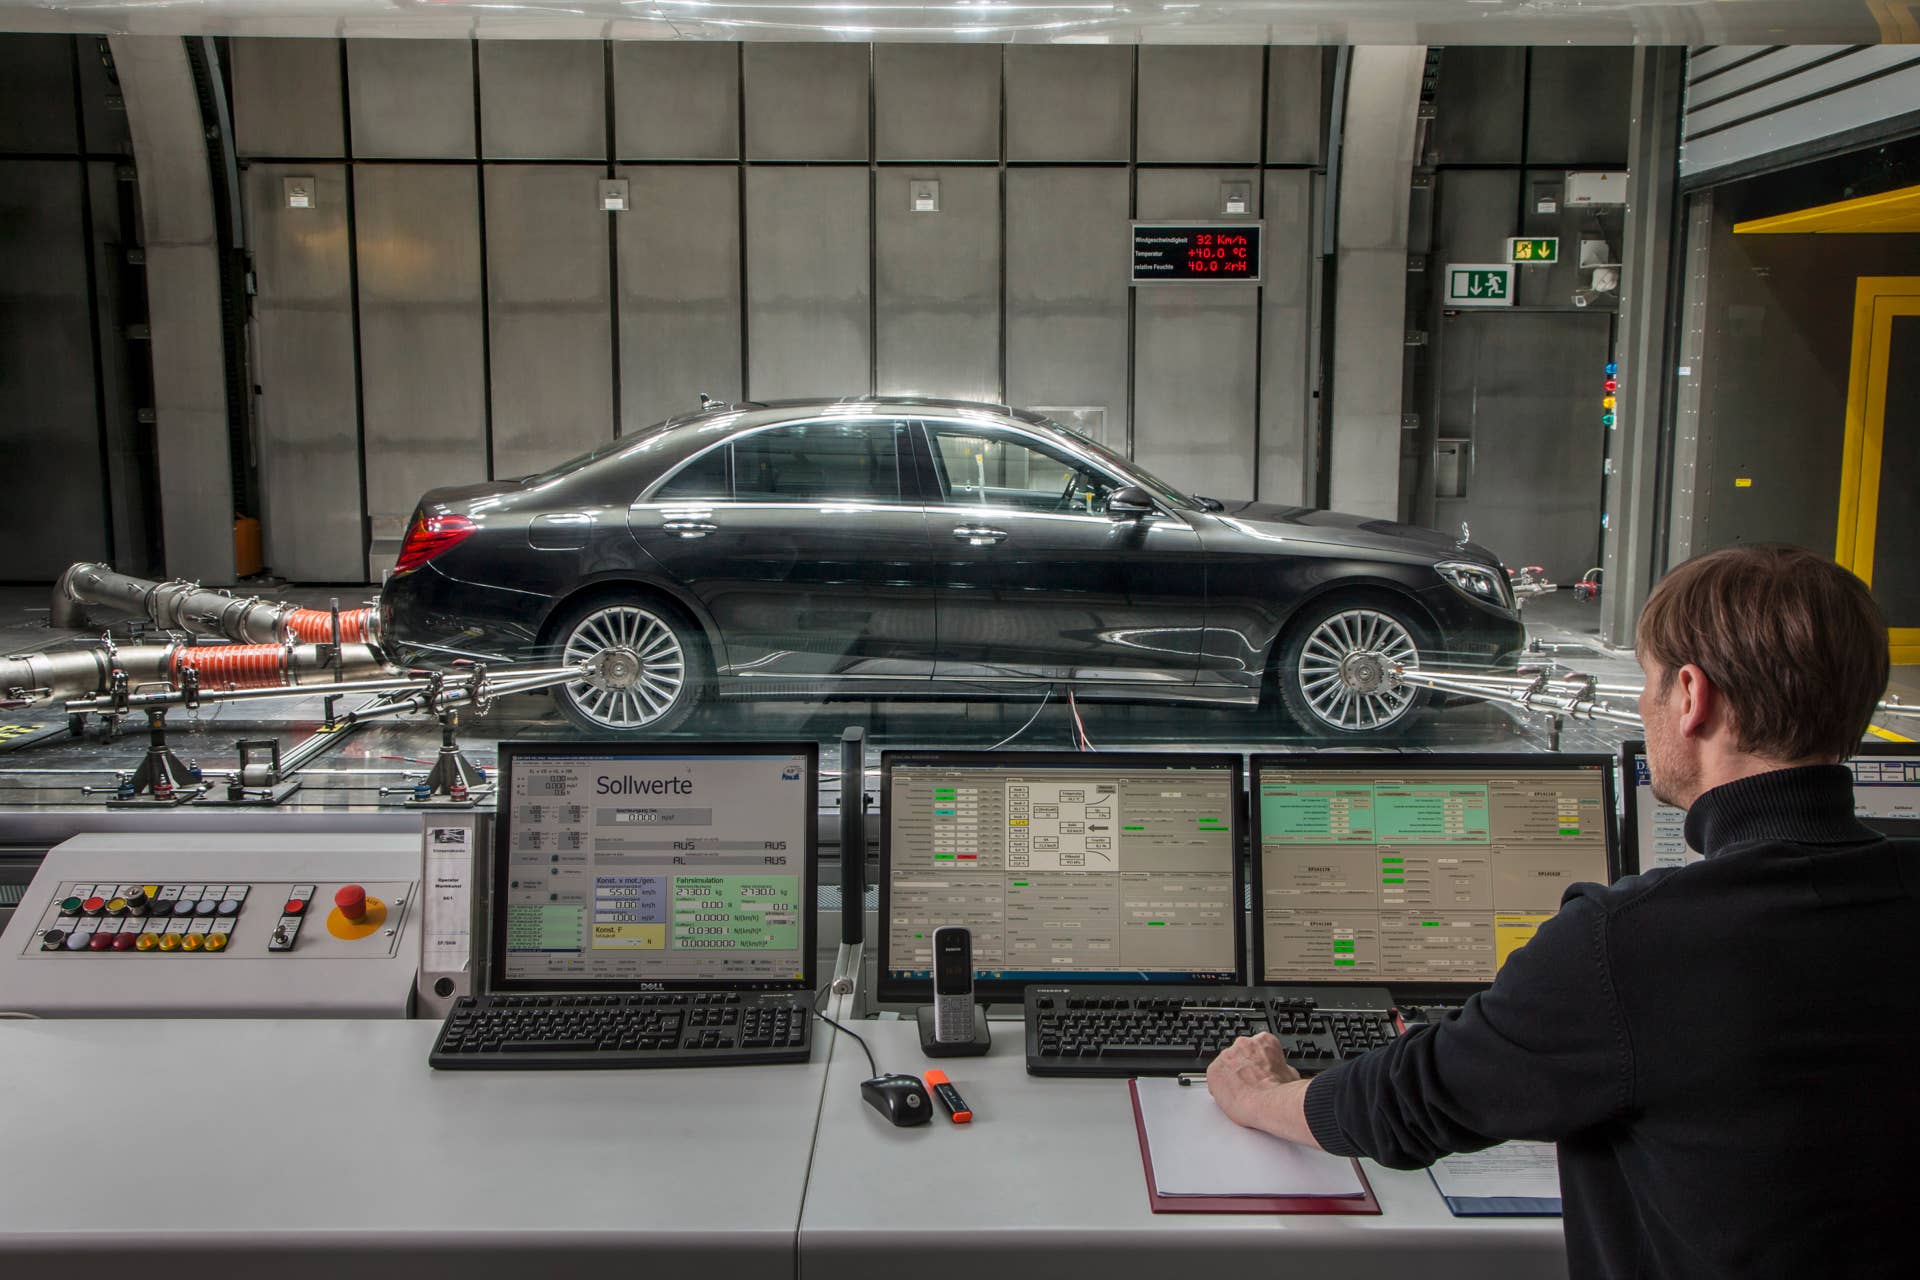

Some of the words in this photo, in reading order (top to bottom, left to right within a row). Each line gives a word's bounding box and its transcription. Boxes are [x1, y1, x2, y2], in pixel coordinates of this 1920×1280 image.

[1196, 234, 1212, 245] 32
[596, 775, 692, 794] Sollwerte
[673, 842, 695, 850] AUS
[764, 842, 786, 850] AUS
[764, 856, 786, 864] AUS
